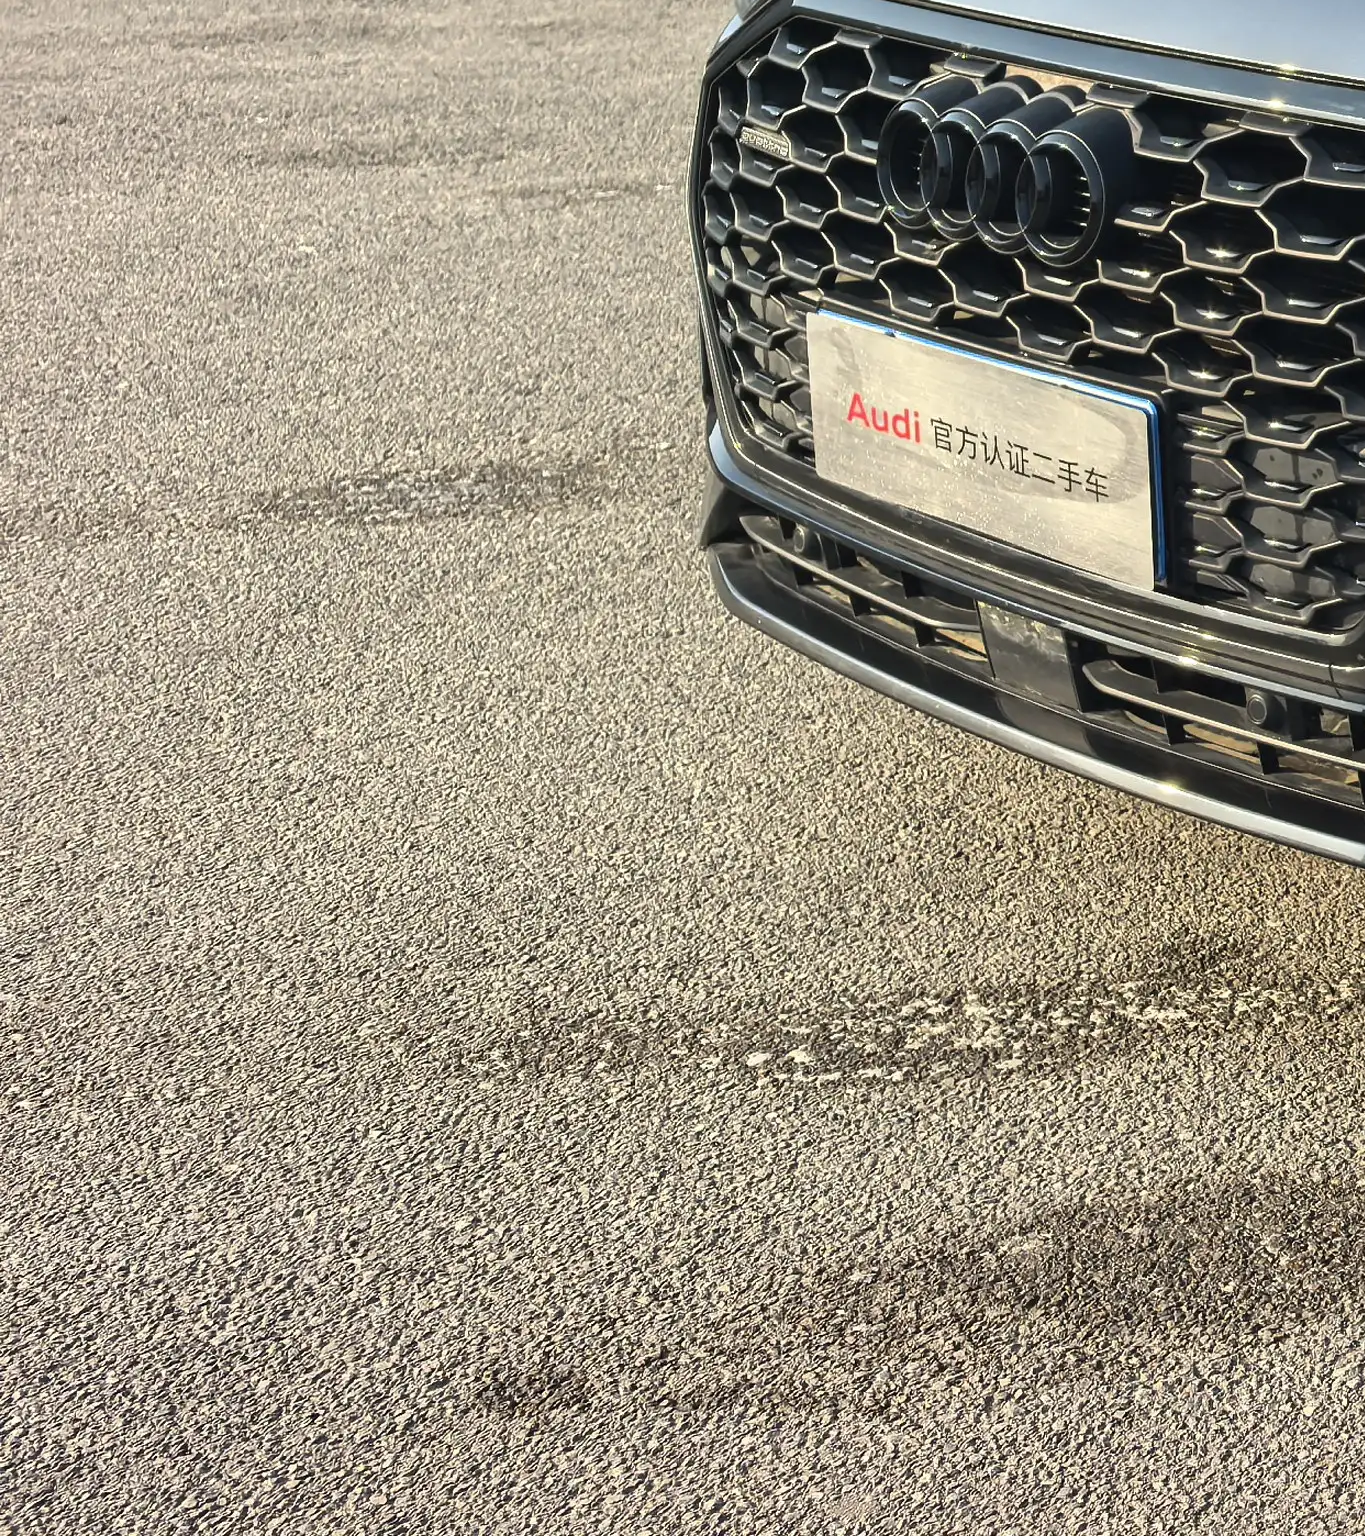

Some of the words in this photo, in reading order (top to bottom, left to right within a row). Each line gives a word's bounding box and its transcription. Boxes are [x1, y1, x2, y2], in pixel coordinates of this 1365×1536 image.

[846, 392, 922, 444] Audi
[930, 417, 1110, 503] 官方认证二手车
